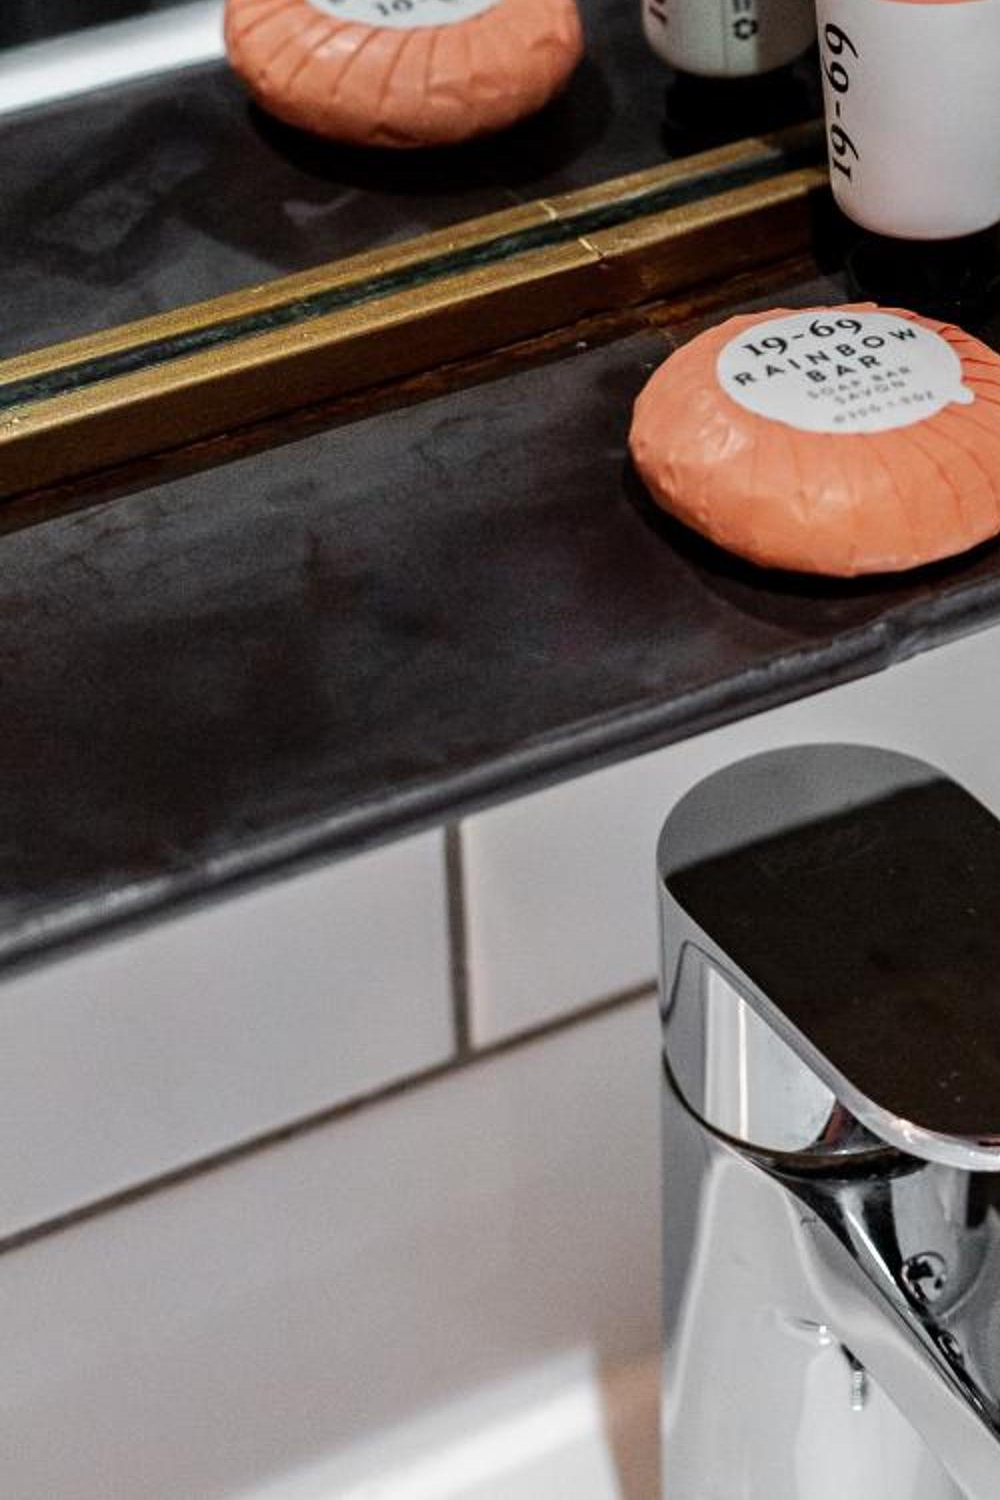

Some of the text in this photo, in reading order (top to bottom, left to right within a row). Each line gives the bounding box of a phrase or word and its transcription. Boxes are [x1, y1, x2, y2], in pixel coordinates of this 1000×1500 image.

[822, 22, 859, 183] 19-69
[734, 327, 917, 387] RAINBOW
[742, 319, 862, 358] 19-69
[805, 354, 882, 384] BAR
